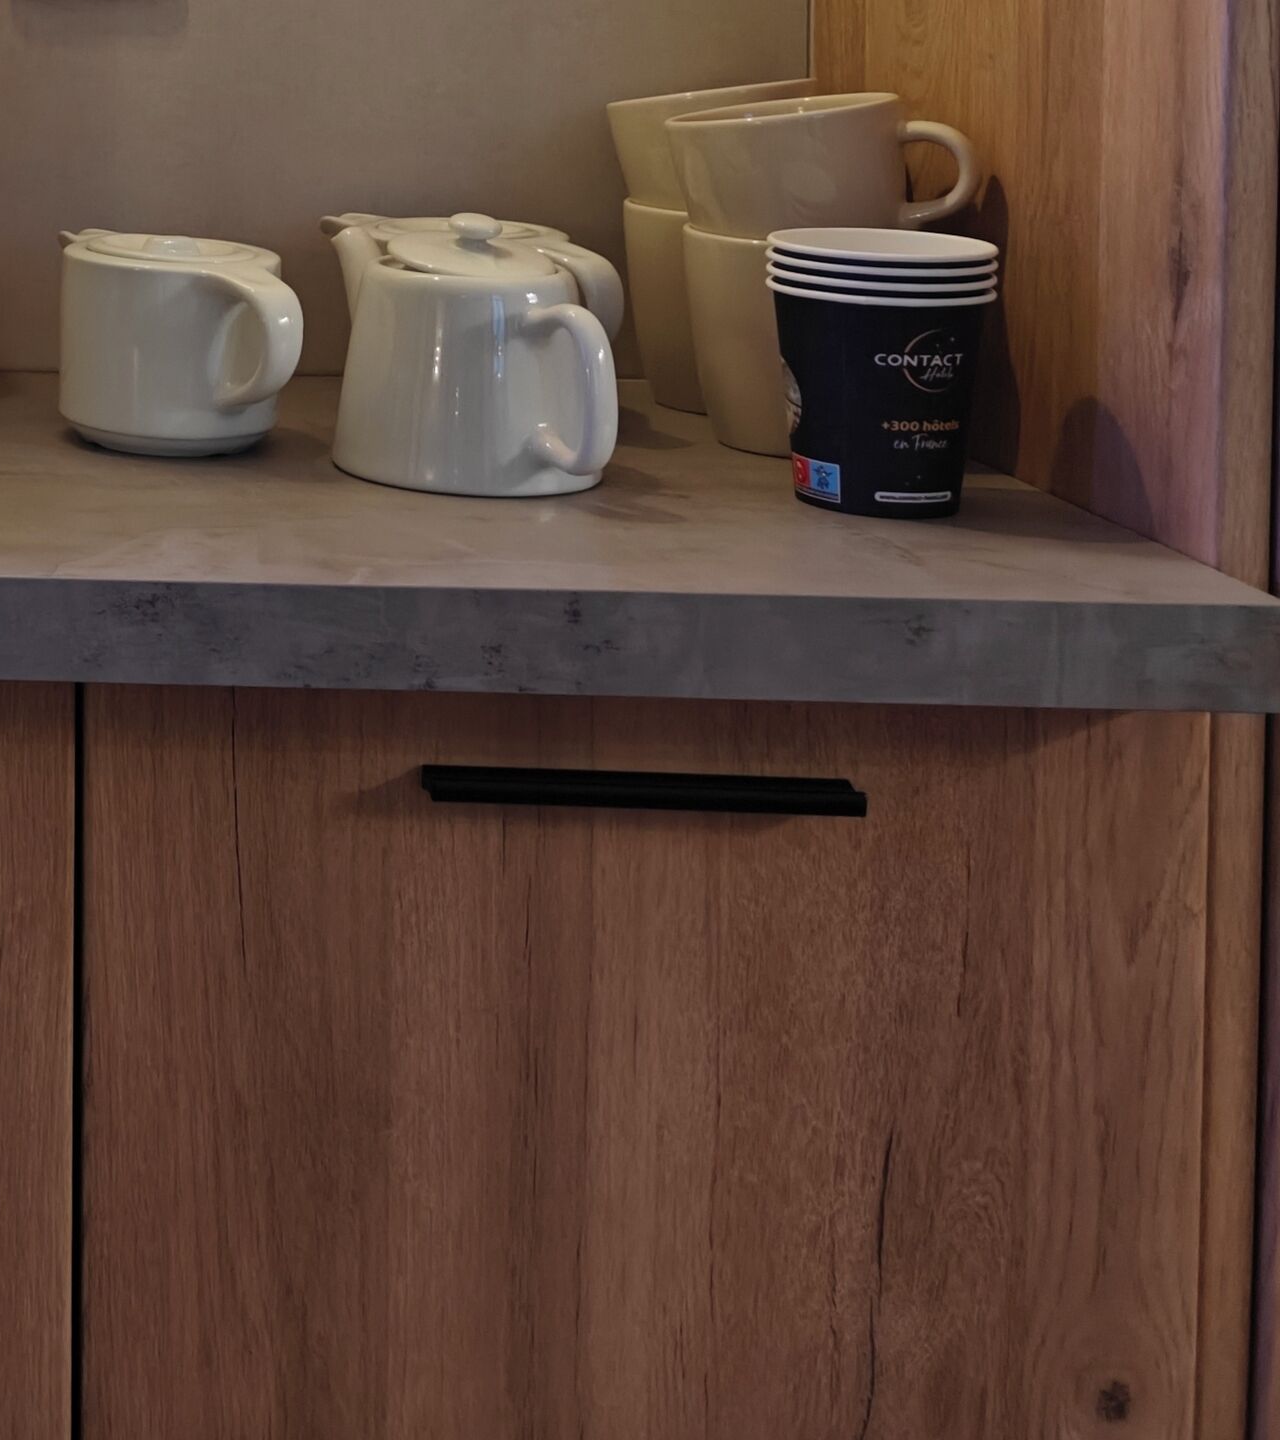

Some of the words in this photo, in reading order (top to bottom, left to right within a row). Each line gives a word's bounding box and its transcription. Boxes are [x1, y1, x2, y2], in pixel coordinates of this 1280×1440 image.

[874, 353, 963, 367] CONTACT
[881, 420, 920, 432] +300
[893, 439, 910, 450] en
